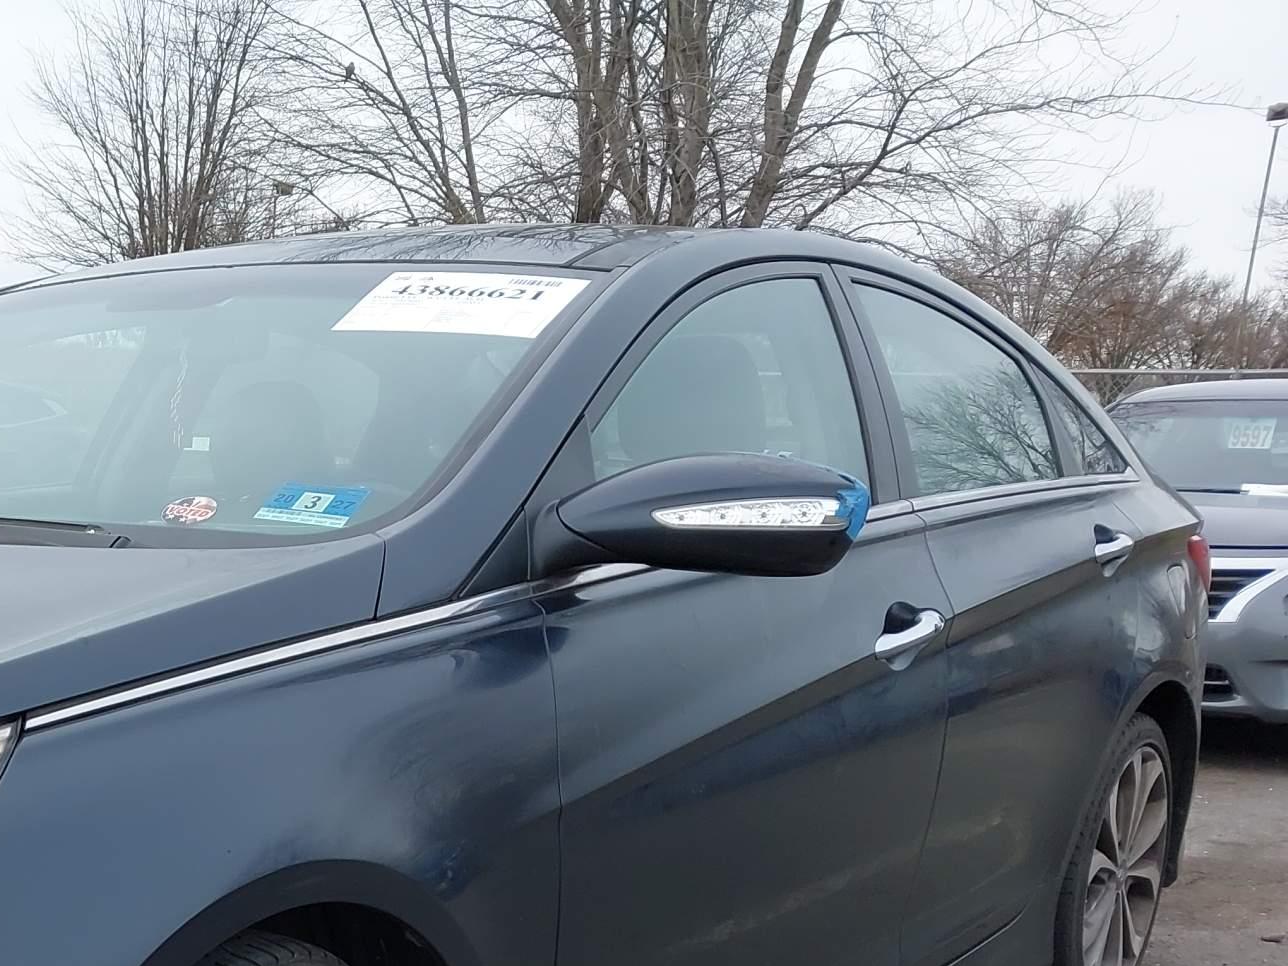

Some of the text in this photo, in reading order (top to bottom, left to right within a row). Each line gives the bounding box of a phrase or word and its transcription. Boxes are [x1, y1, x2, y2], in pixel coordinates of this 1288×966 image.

[391, 284, 546, 301] 43866621
[304, 495, 322, 509] 3
[332, 499, 356, 510] 27
[167, 505, 211, 518] VOTED
